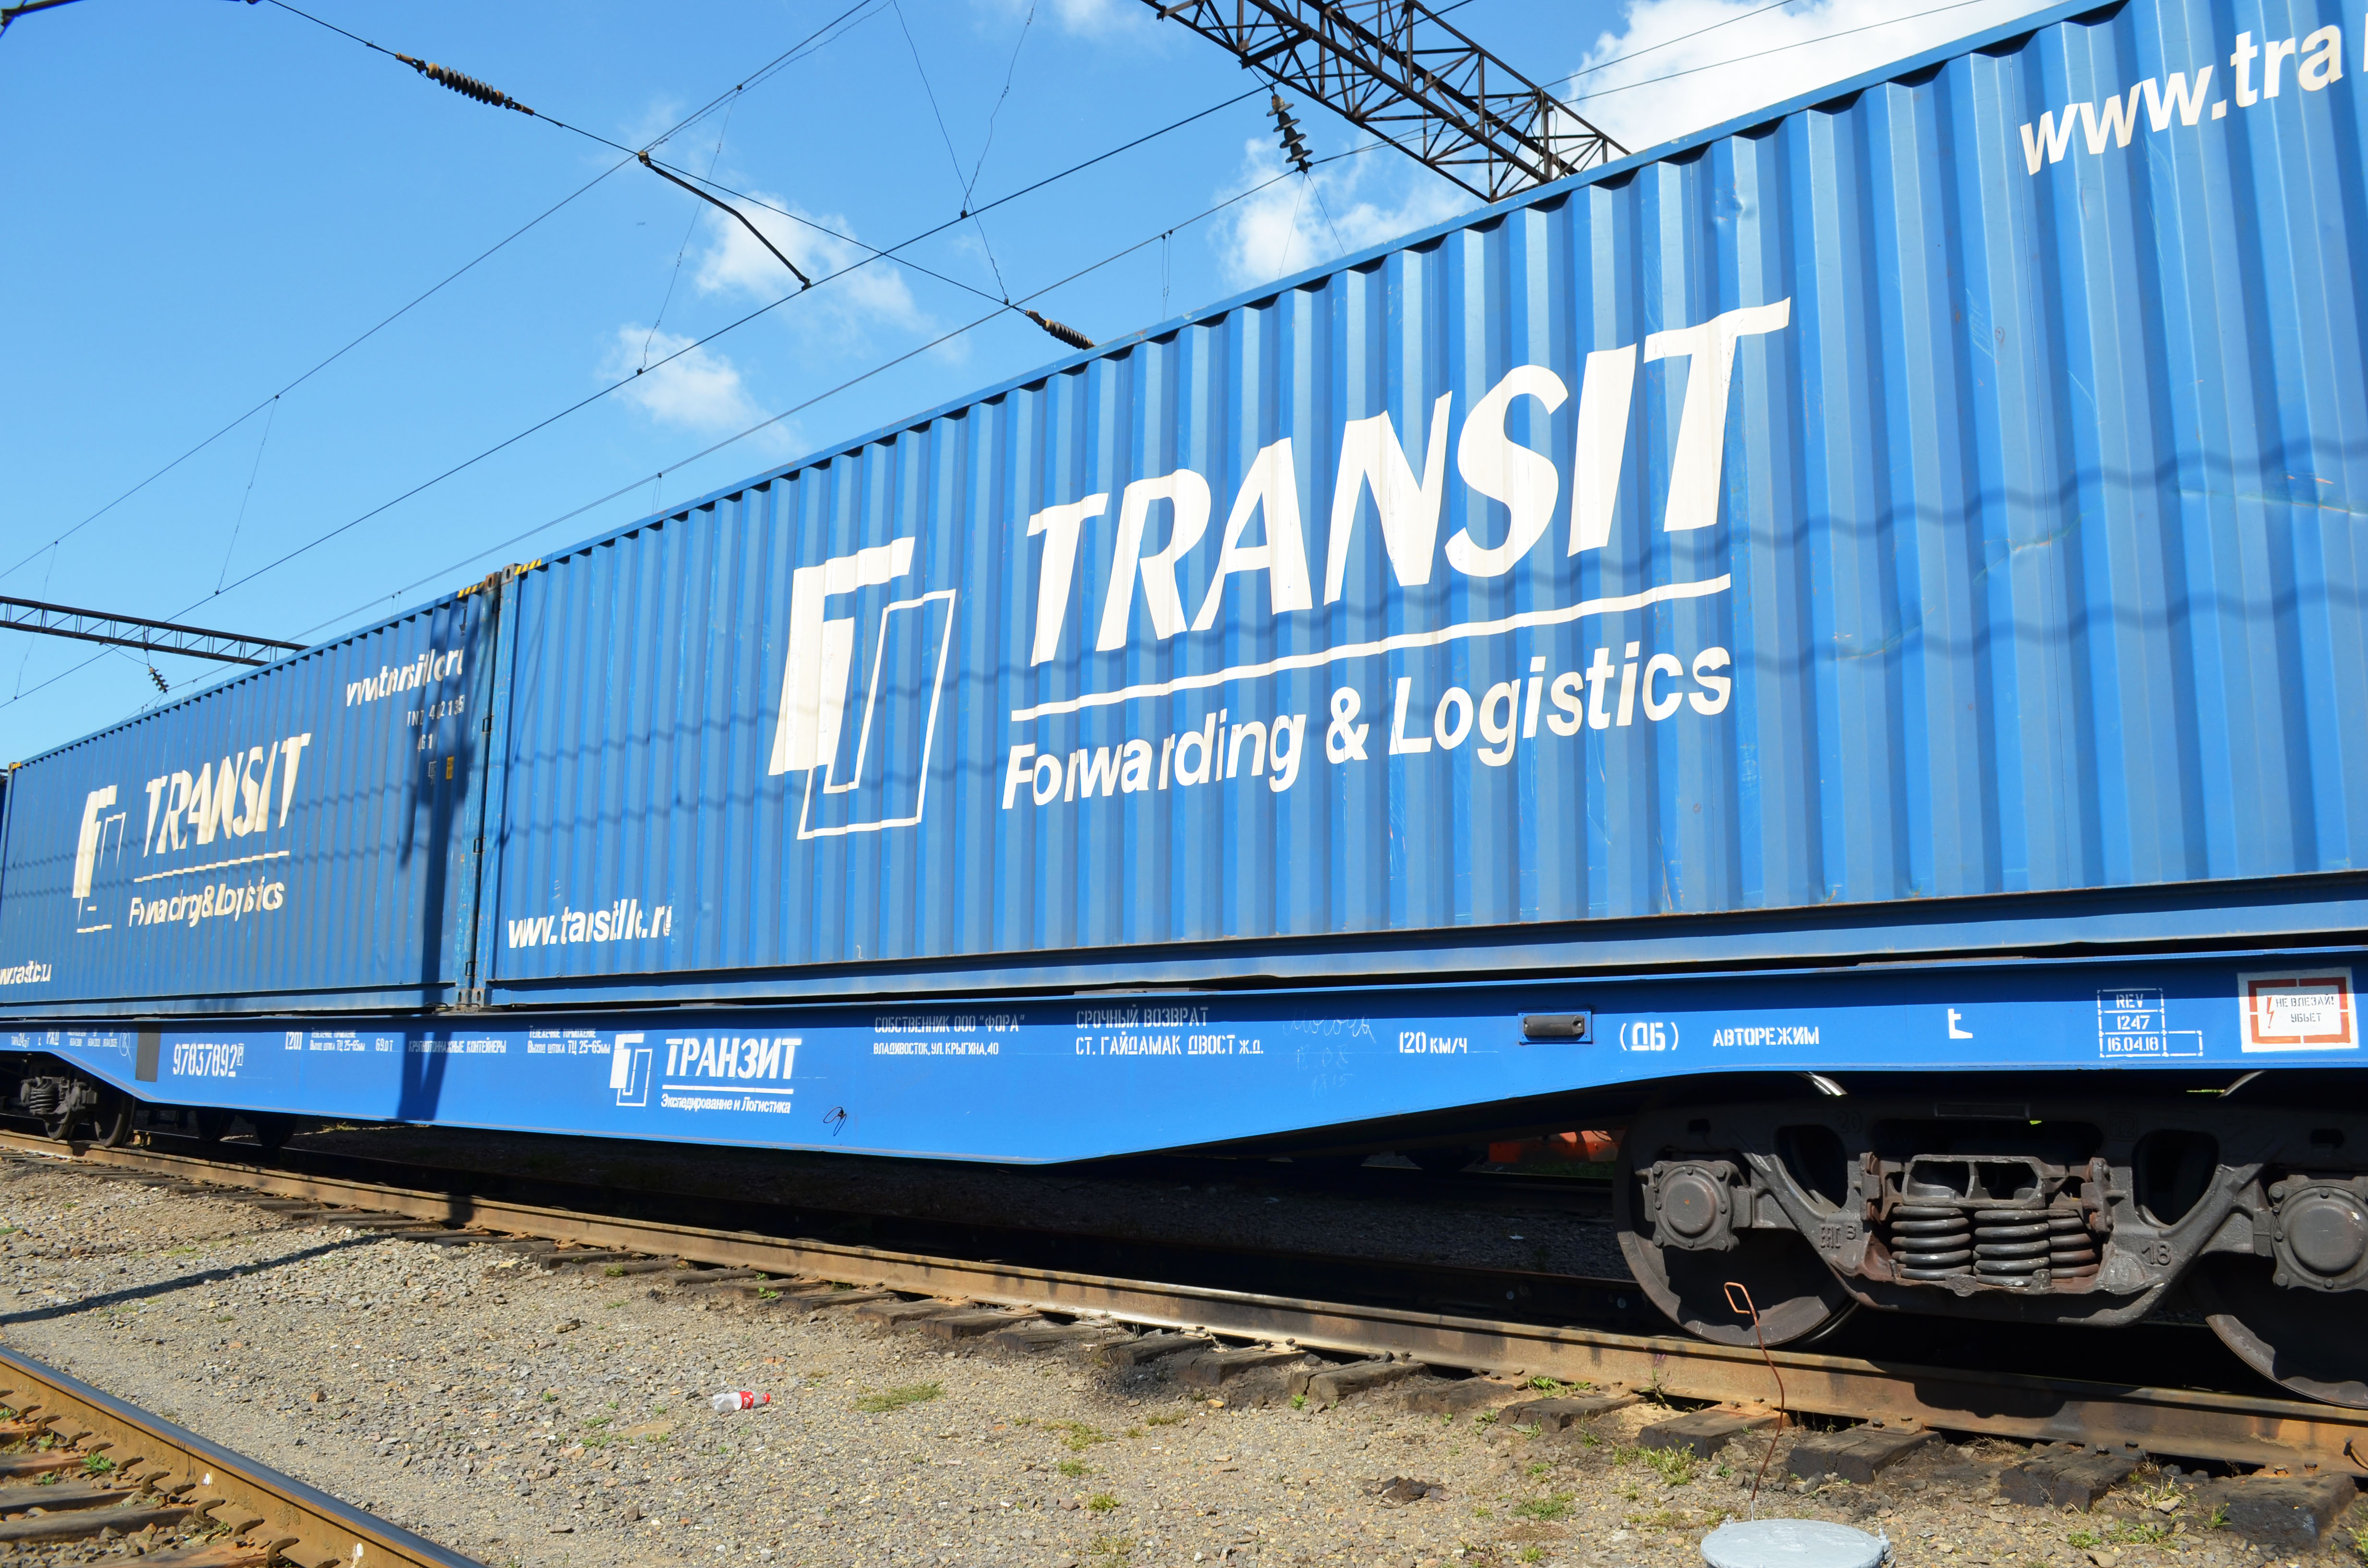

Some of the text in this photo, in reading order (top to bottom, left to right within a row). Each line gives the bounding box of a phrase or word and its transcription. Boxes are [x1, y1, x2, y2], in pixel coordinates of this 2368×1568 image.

[1026, 296, 1791, 667] TRANSIT
[1002, 640, 1732, 809] Forwarding & Logistics
[143, 733, 311, 858] TRANSIT
[202, 885, 215, 918] &
[2116, 994, 2144, 1008] REV
[2276, 998, 2288, 1007] НЕ
[875, 1016, 950, 1033] СОБСТВЕННИК
[953, 1015, 976, 1032] ООО
[1076, 1004, 1209, 1029] СРОЧНЫЙ ВОЗВРАТ
[2117, 1015, 2150, 1030] 1247
[2291, 1013, 2322, 1022] УБЬЕТ
[408, 1037, 506, 1053] КРУПНОТОННАЖНЫЕ КОНТЕЙНЕРЫ
[1076, 1036, 1096, 1055] СТ.
[1100, 1031, 1182, 1055] ГАЙДАМАК
[1187, 1035, 1235, 1054] ДВОСТ
[1399, 1031, 1427, 1054] 120
[1713, 1027, 1819, 1046] АВТОРЕЖИМ
[2108, 1036, 2159, 1052] 16.04.18
[173, 1043, 236, 1078] 97837892
[666, 1038, 802, 1079] ТРАНЗИТ
[661, 1093, 791, 1114] Экспедирование и Логистика
[2141, 1241, 2171, 1266] 18
